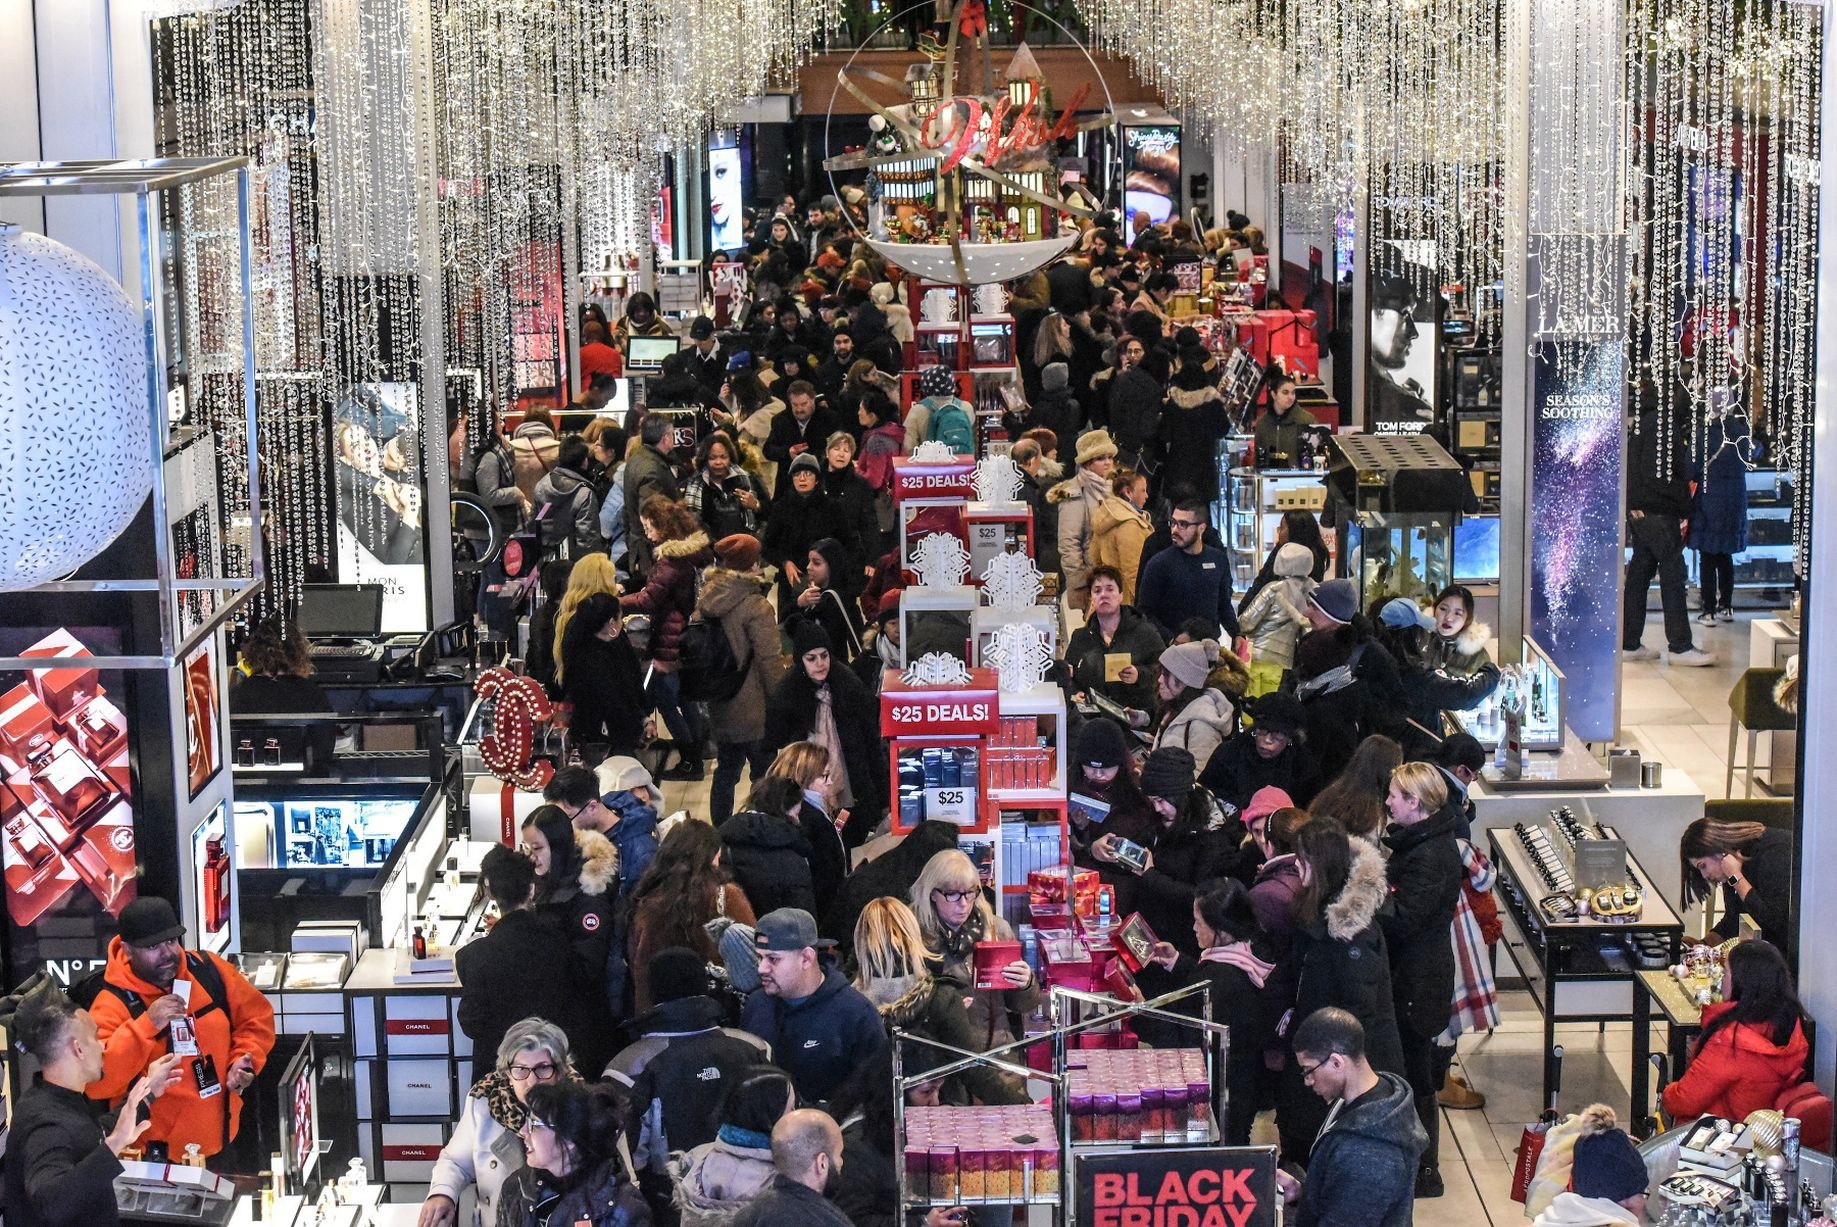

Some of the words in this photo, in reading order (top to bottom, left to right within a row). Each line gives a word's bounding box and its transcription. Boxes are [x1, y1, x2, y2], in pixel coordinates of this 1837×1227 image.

[1538, 317, 1569, 333] LA
[1575, 316, 1620, 333] MER
[1546, 395, 1610, 406] SEASON'S
[1542, 407, 1613, 418] SOOTHING
[1375, 421, 1398, 431] TOM
[1399, 421, 1427, 431] FORD
[902, 476, 923, 488] $25
[926, 474, 971, 487] DEALS!
[979, 528, 996, 538] $25
[368, 577, 397, 586] MON
[383, 586, 405, 595] RIS
[892, 706, 922, 722] $25
[927, 704, 989, 722] DEALS!
[938, 790, 964, 805] $25
[195, 1063, 206, 1088] PRESS
[1094, 1168, 1257, 1207] BLACK
[1094, 1203, 1257, 1227] FRIDAY
